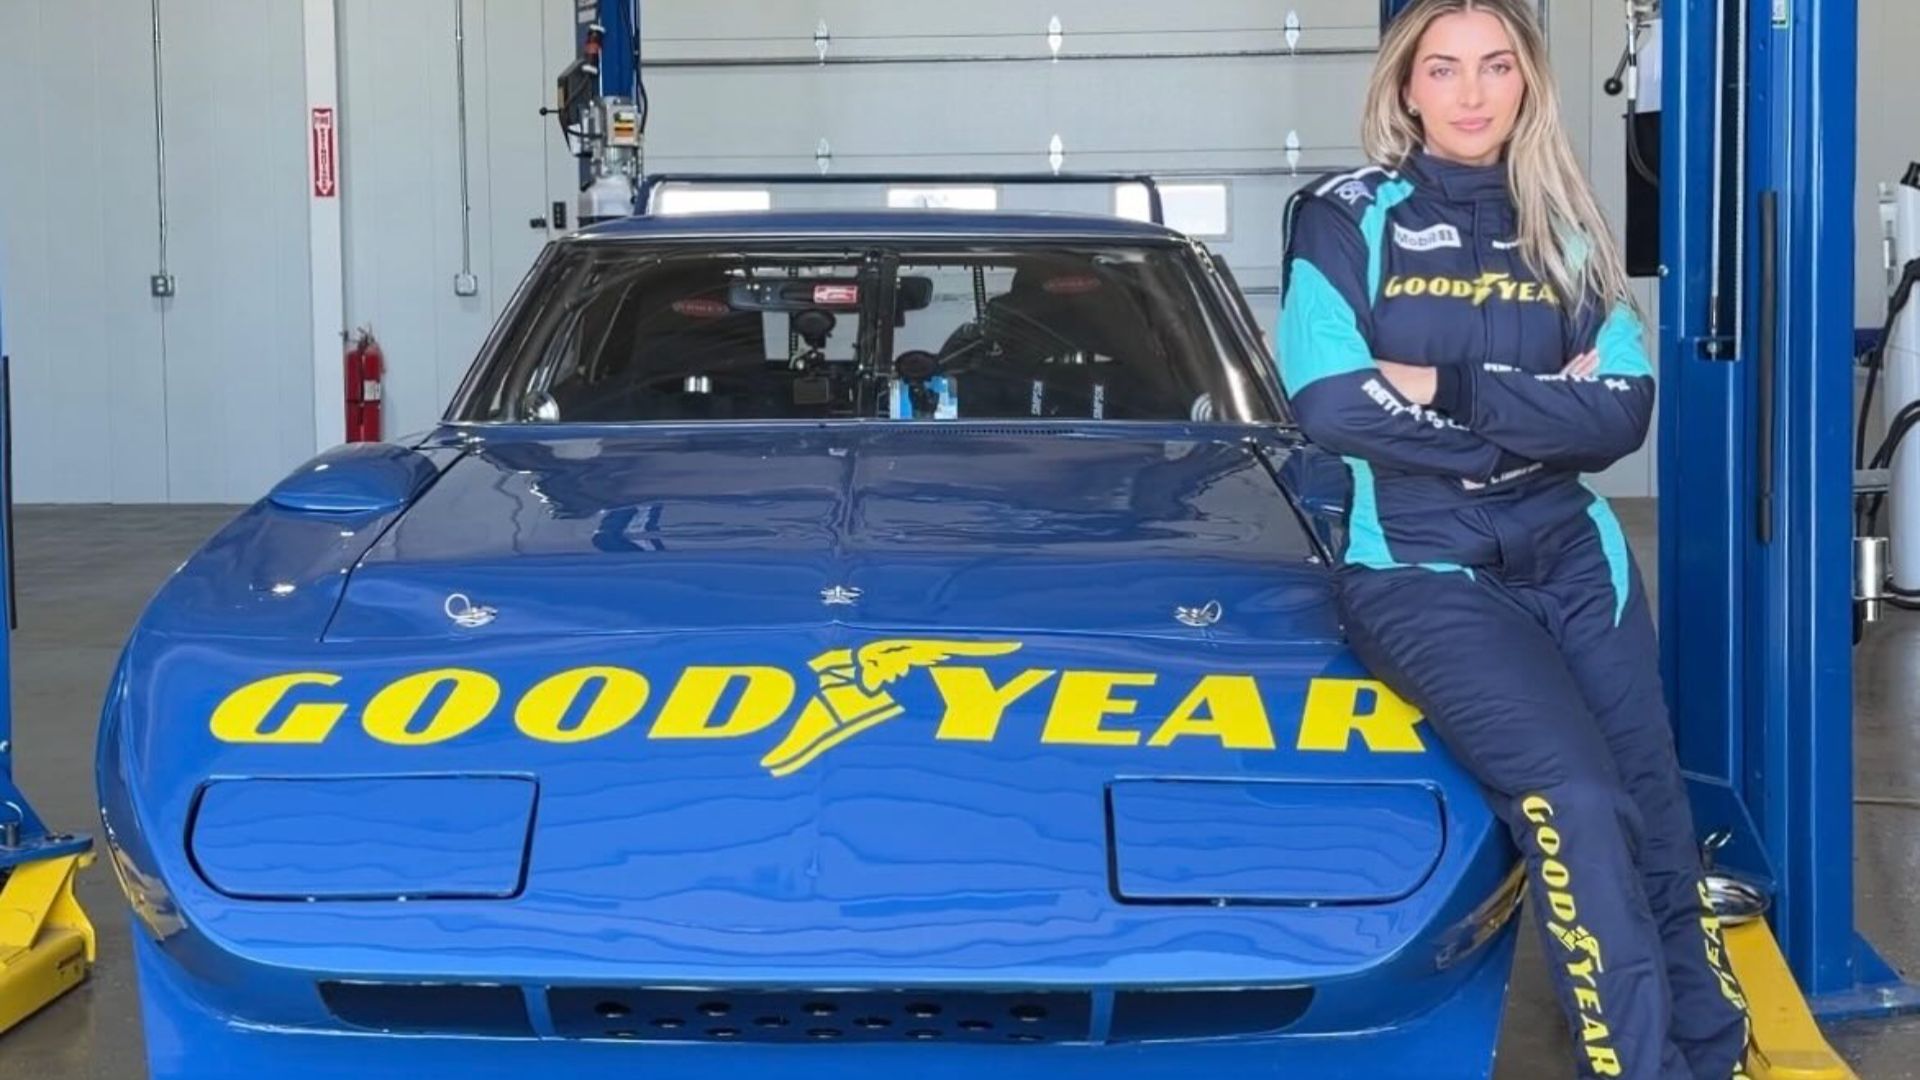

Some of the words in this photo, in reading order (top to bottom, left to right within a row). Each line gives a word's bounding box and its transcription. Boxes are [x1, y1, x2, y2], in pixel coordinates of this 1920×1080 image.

[1396, 230, 1437, 246] Mobil
[1384, 274, 1557, 304] GOODYEA
[209, 664, 1426, 754] GOODYEAR
[1522, 795, 1622, 1077] GOODYEAR
